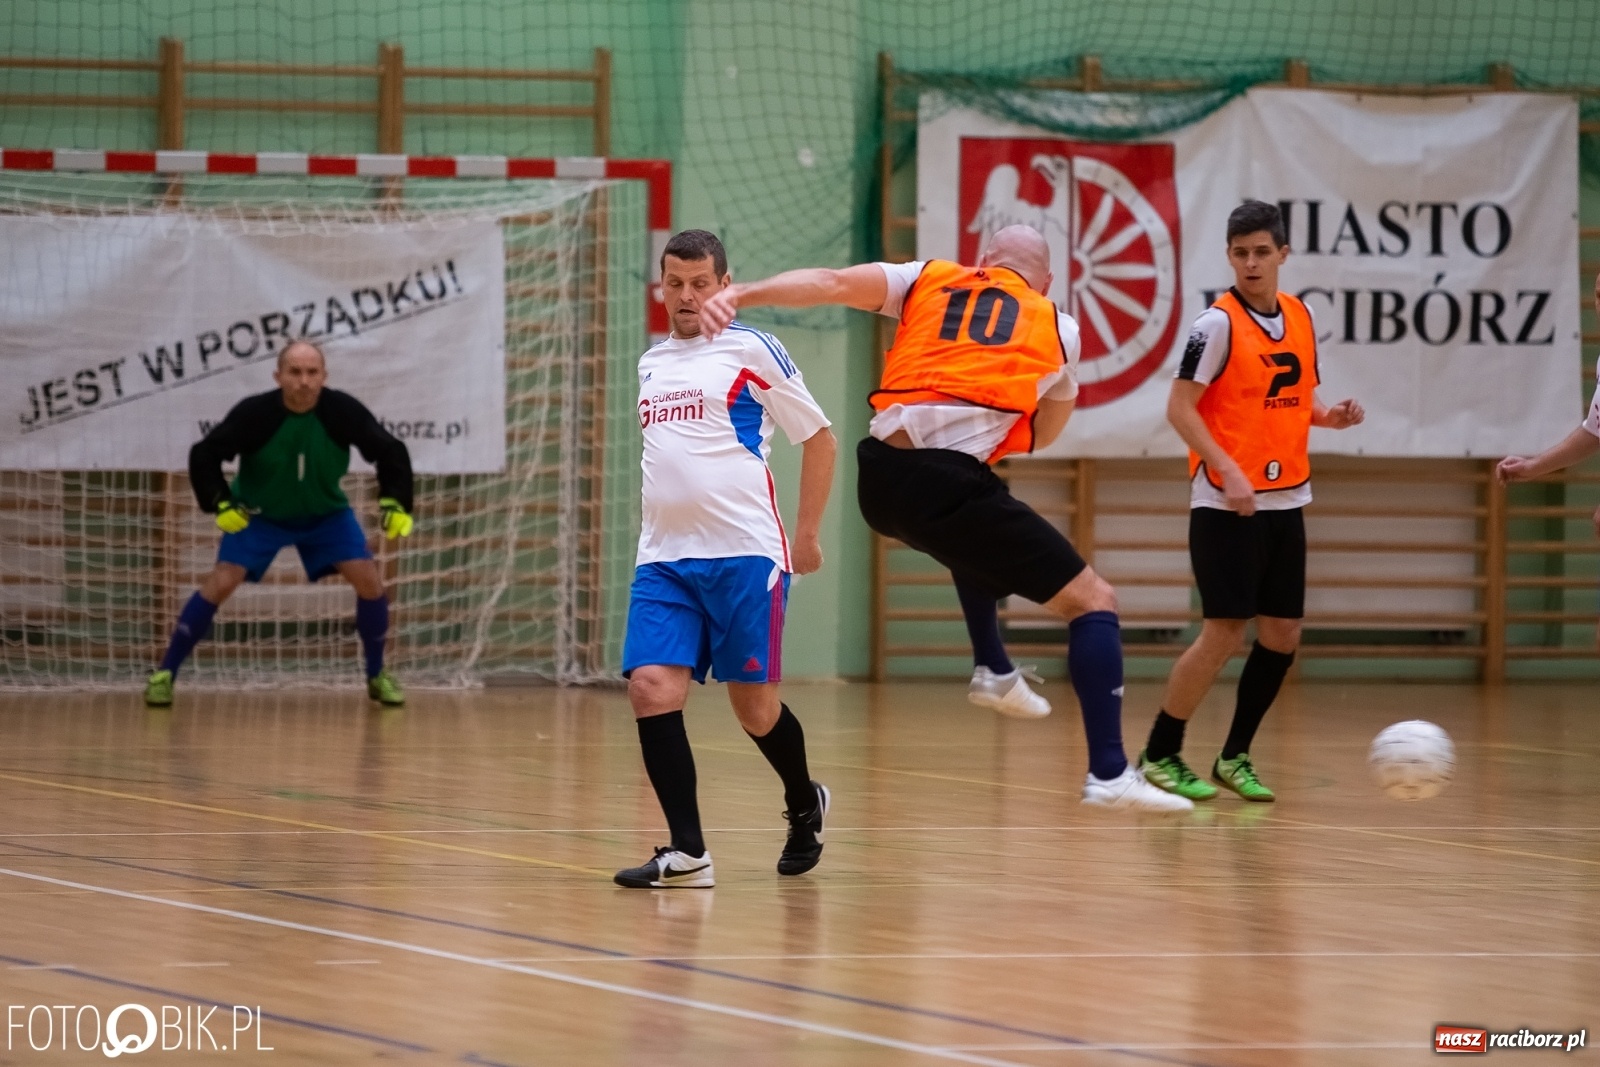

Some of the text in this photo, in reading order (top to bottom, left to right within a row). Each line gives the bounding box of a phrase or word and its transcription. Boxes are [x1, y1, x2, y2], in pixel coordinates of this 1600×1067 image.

[939, 286, 1020, 345] 10
[1203, 273, 1555, 346] CIBÓRZ
[19, 259, 464, 427] JEST W PORZĄDKU!
[638, 399, 704, 429] Gianni
[652, 389, 704, 404] CUKIERNIA
